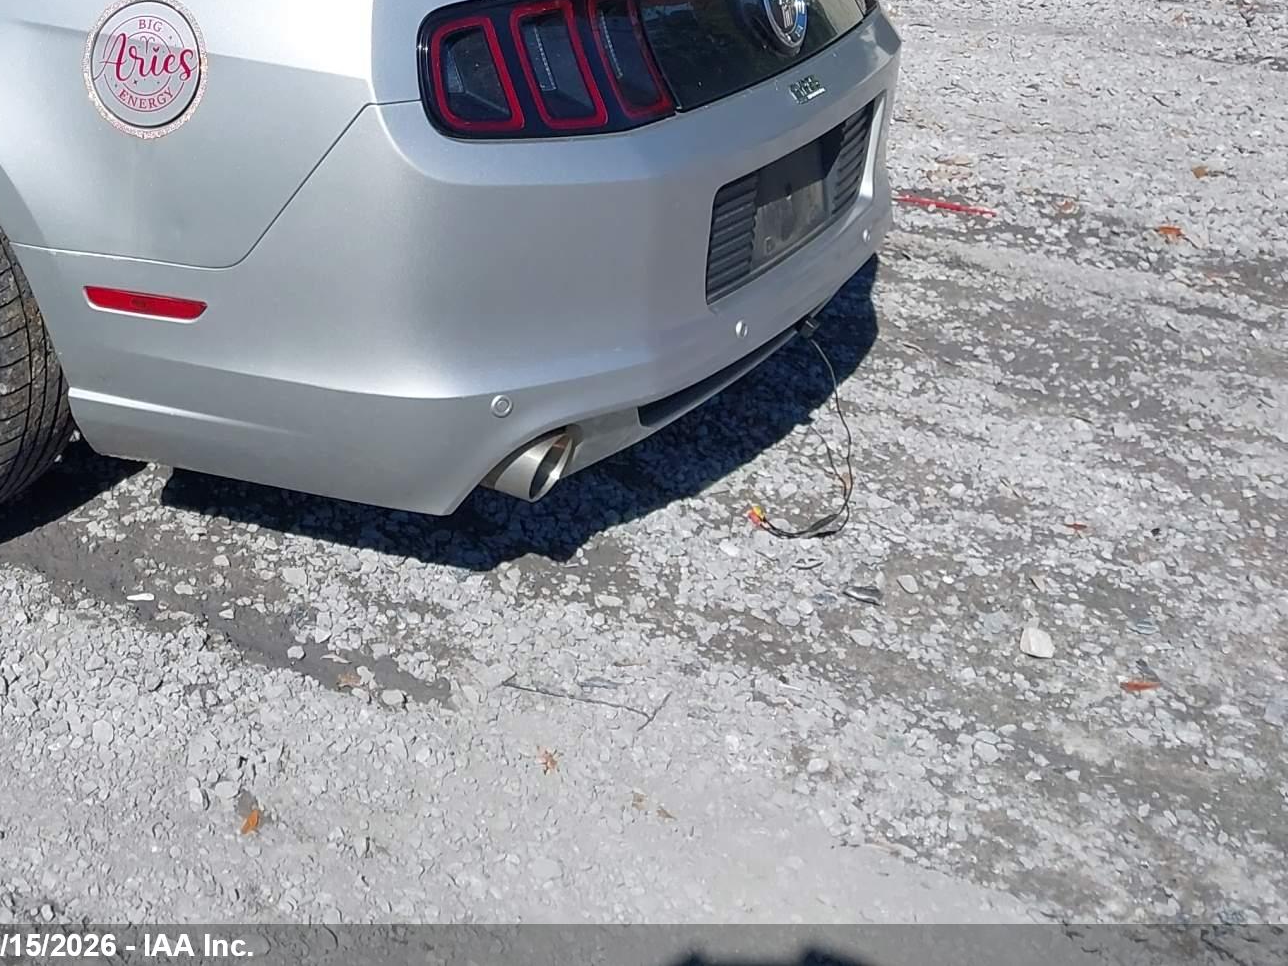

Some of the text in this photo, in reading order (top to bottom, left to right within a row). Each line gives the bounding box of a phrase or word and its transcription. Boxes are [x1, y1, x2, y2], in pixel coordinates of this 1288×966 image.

[138, 19, 163, 32] BIG
[92, 32, 198, 82] Aries
[118, 86, 174, 110] ENERGY
